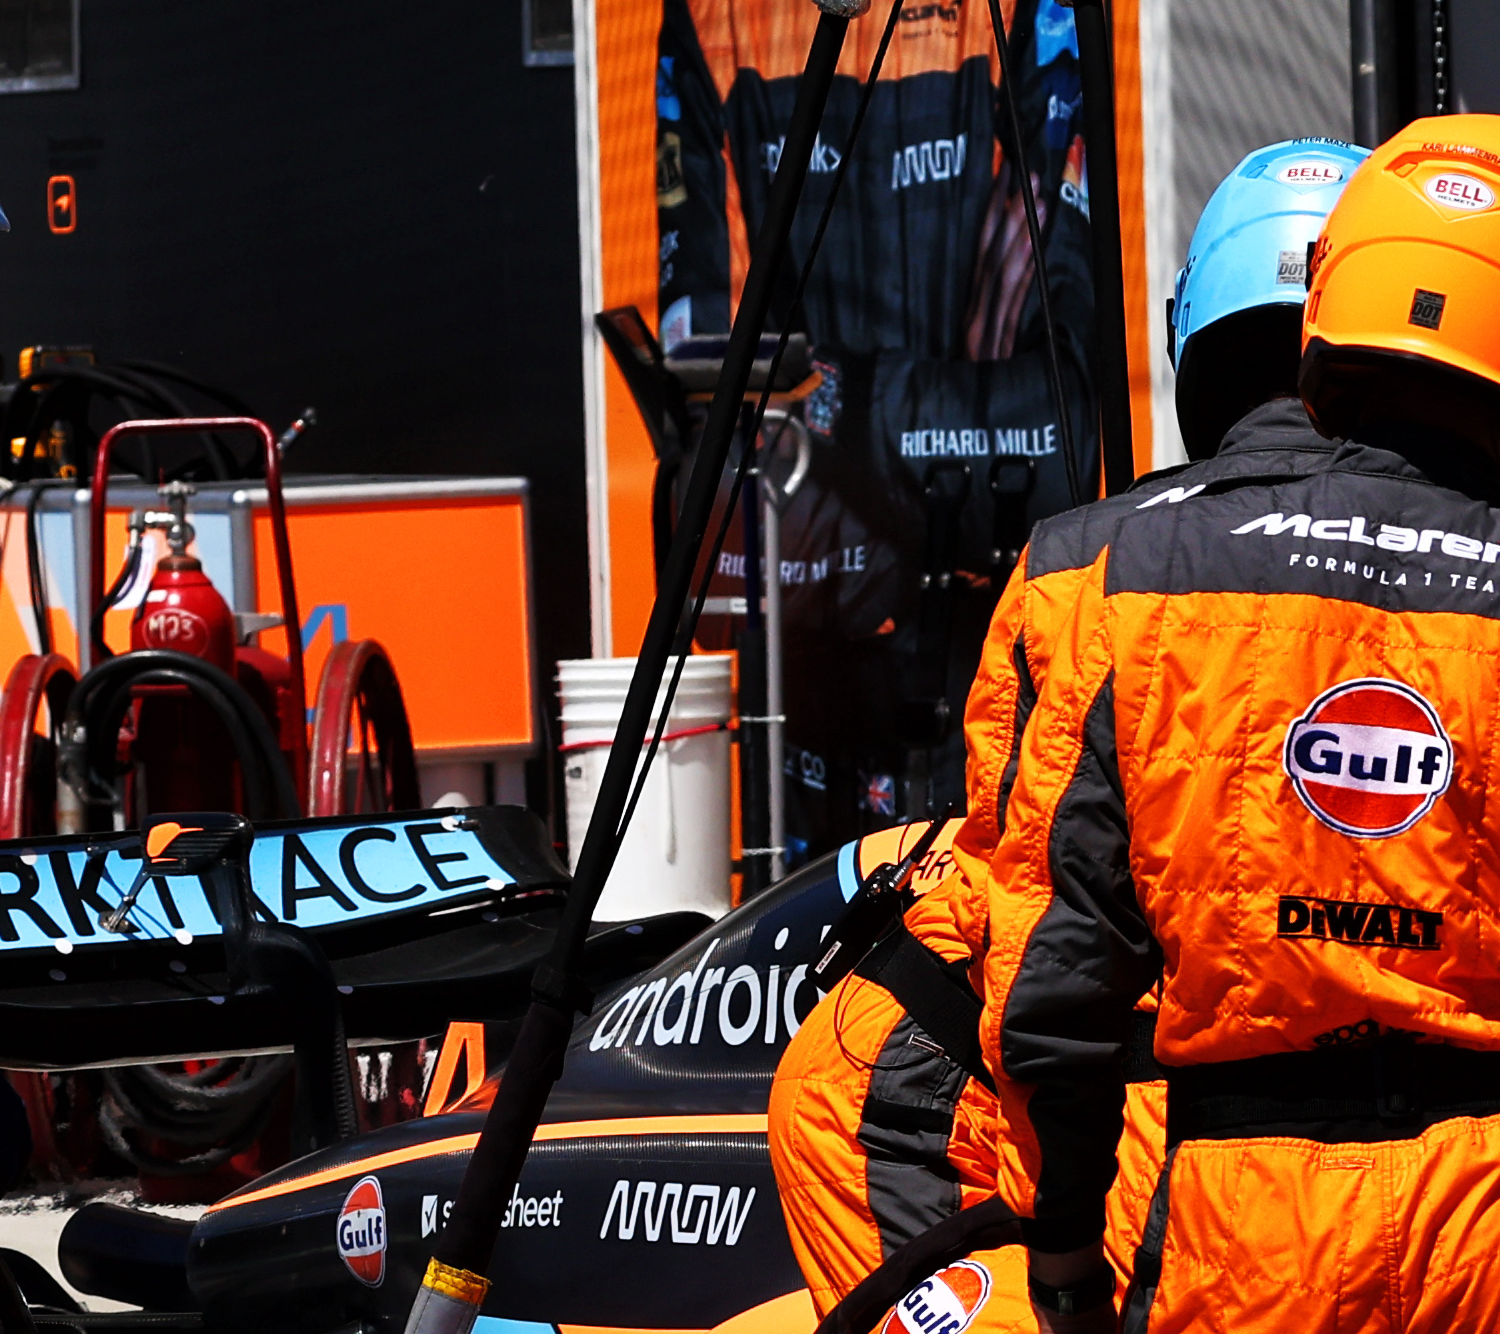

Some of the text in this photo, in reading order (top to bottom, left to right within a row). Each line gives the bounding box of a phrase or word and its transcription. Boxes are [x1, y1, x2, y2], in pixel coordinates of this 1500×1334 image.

[1292, 137, 1352, 149] PETER MAZE
[1287, 167, 1334, 179] BELL
[1435, 178, 1484, 203] BELL
[1437, 194, 1476, 208] HELMETS
[1279, 262, 1307, 276] DOT
[1412, 302, 1443, 320] DOT
[900, 423, 1056, 458] RICHARD MILLE
[1288, 552, 1410, 588] FORMULA
[1424, 556, 1433, 575] 1
[1294, 729, 1443, 788] Gulf
[1277, 896, 1443, 952] DEWALT
[599, 1179, 757, 1247] ARROW
[338, 1208, 386, 1253] Gulf
